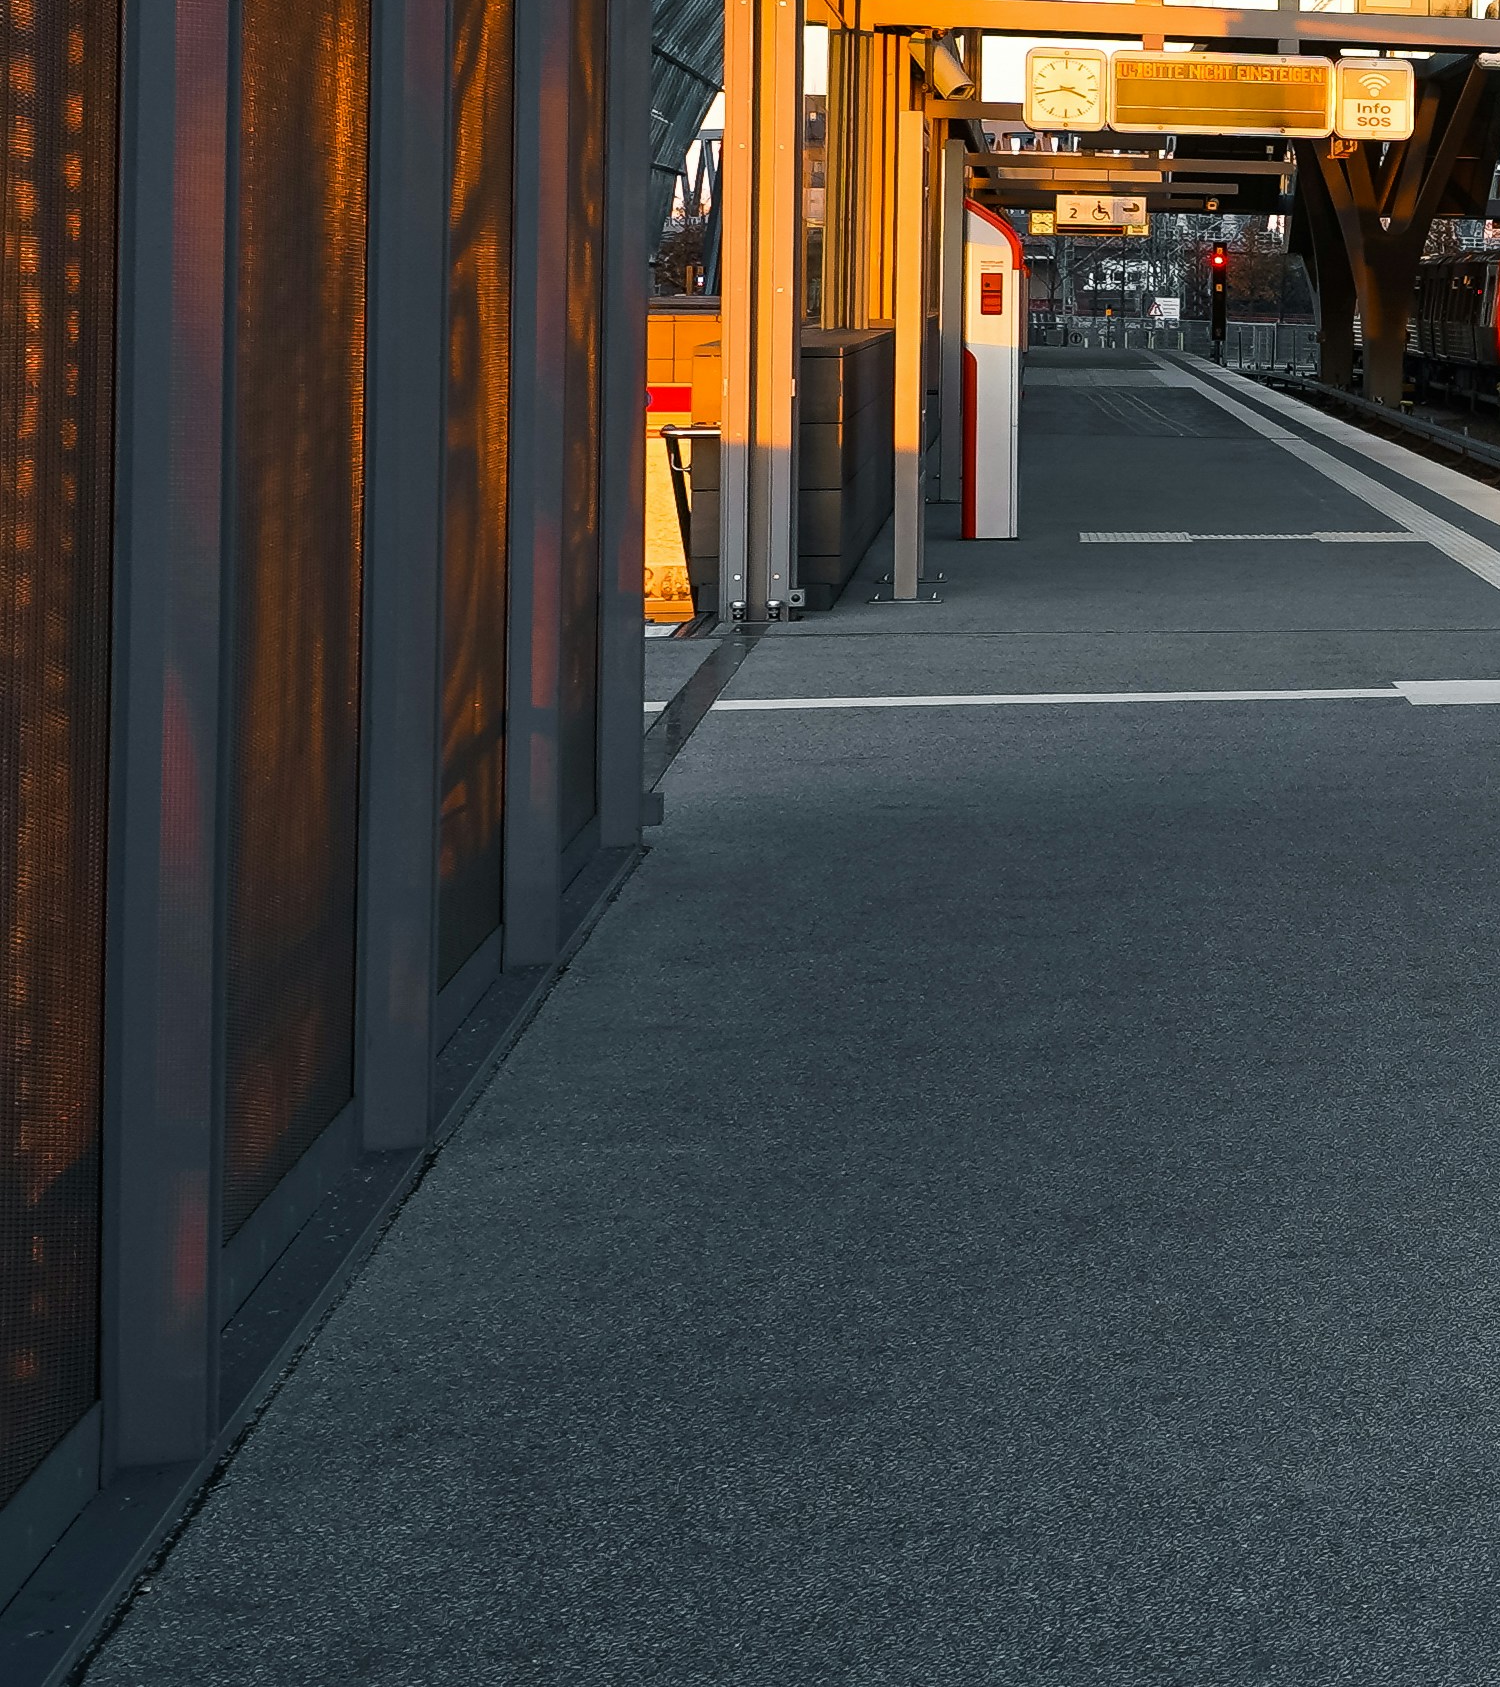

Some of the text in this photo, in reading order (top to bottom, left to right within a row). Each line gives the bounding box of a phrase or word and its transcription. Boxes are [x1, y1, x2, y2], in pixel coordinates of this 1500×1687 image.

[1143, 62, 1185, 79] BITTE
[1189, 64, 1233, 81] NICHT
[1237, 65, 1323, 83] EINSTEIGEN
[1357, 102, 1391, 114] Info
[1357, 116, 1392, 127] SOS
[1069, 207, 1078, 218] 2
